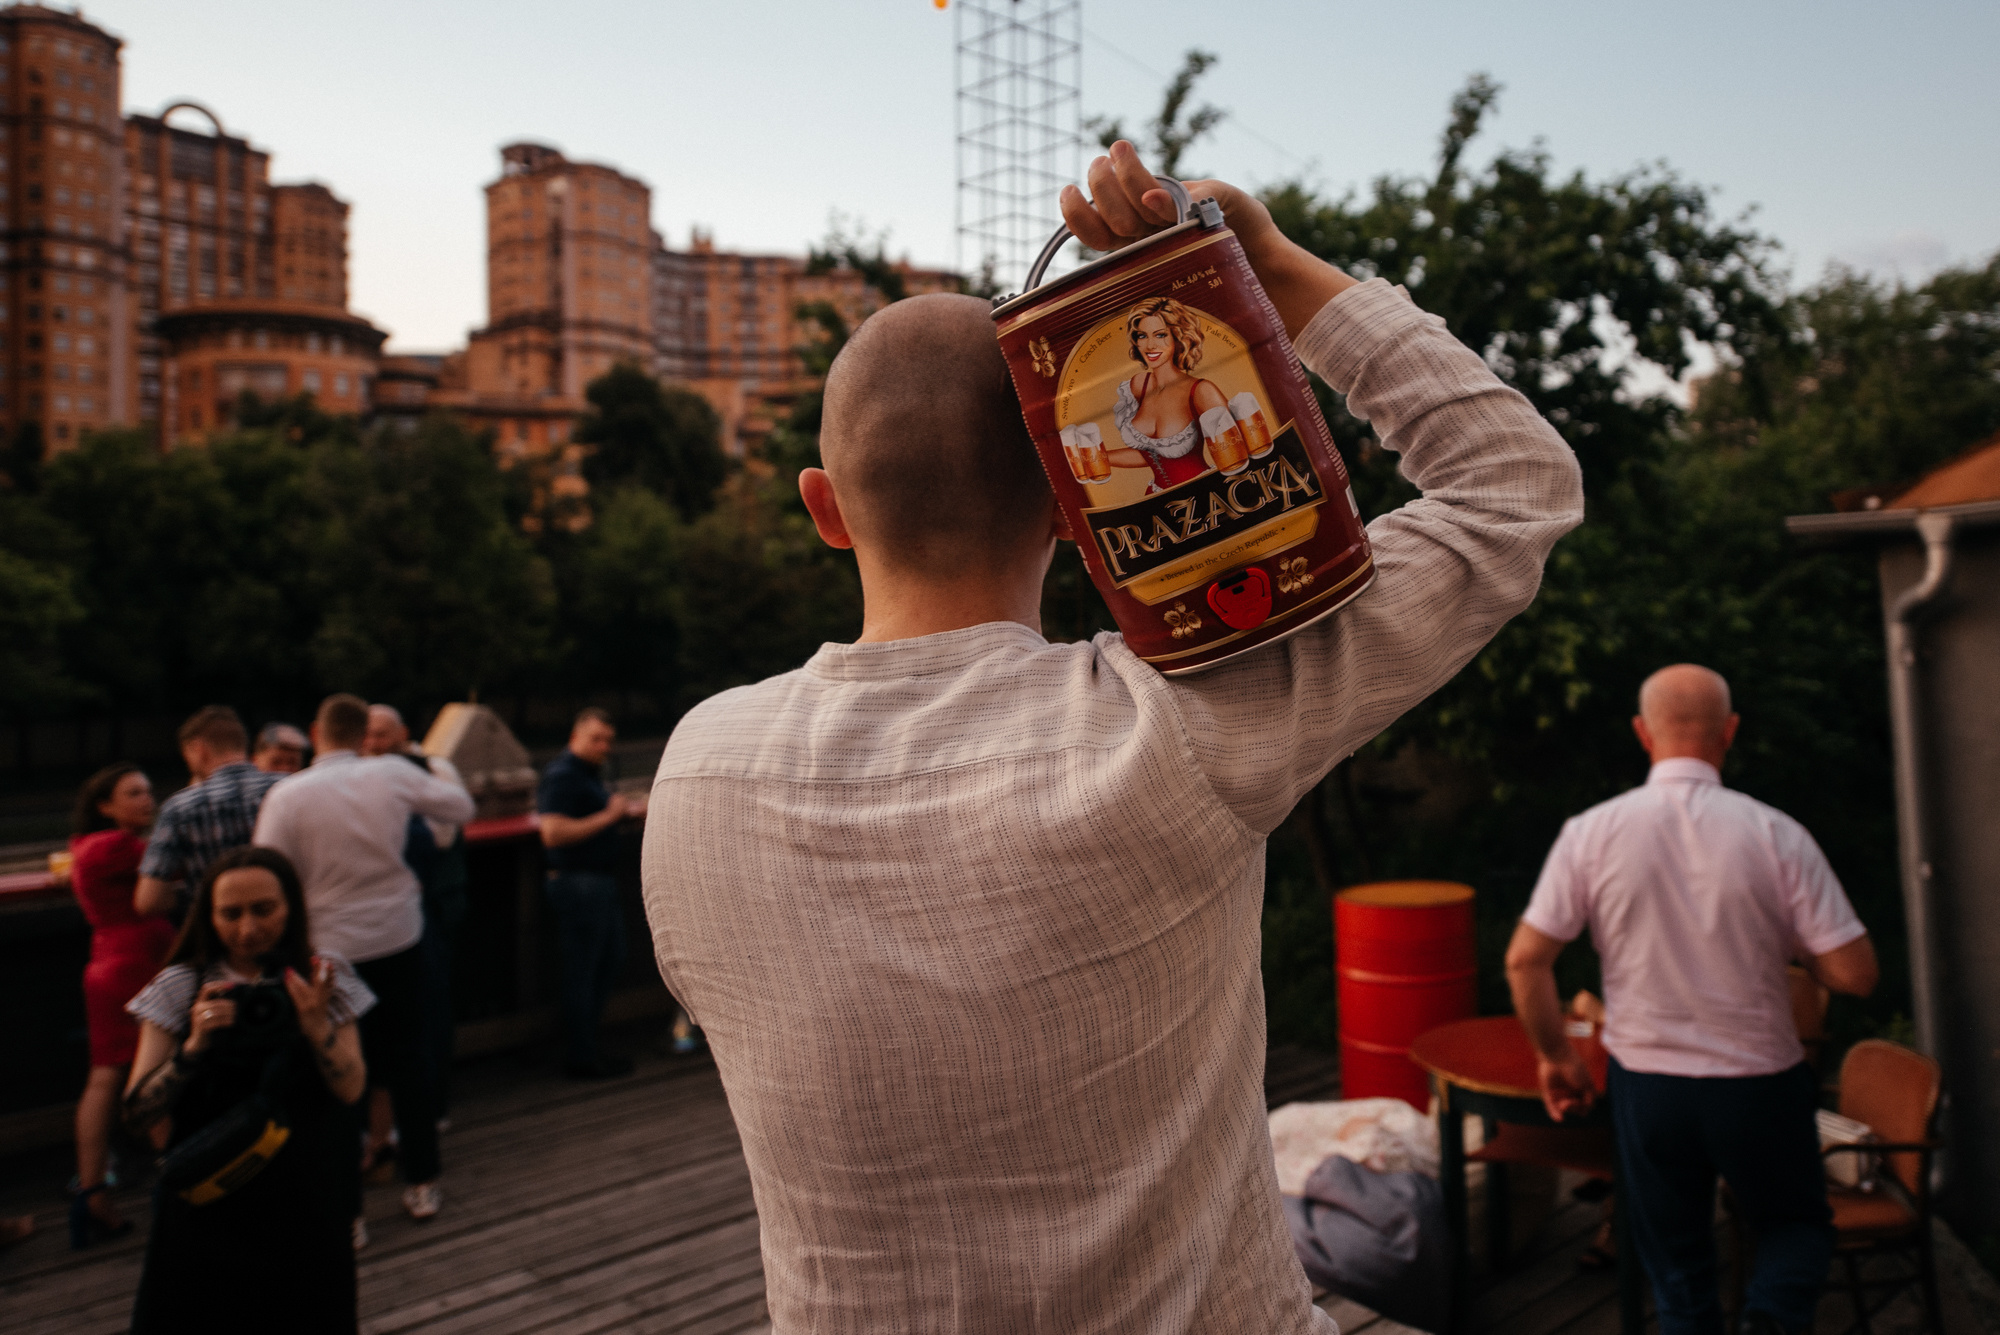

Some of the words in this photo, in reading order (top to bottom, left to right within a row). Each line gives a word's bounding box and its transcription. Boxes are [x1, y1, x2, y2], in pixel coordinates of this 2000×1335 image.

[1079, 343, 1098, 364] Czech
[1095, 332, 1112, 346] Beer
[1206, 325, 1221, 338] Pale
[1222, 334, 1237, 349] Beer
[1165, 565, 1195, 581] Brewed
[1195, 559, 1205, 570] in
[1204, 556, 1219, 566] the
[1218, 545, 1244, 560] Czech
[1244, 528, 1280, 549] Republic
